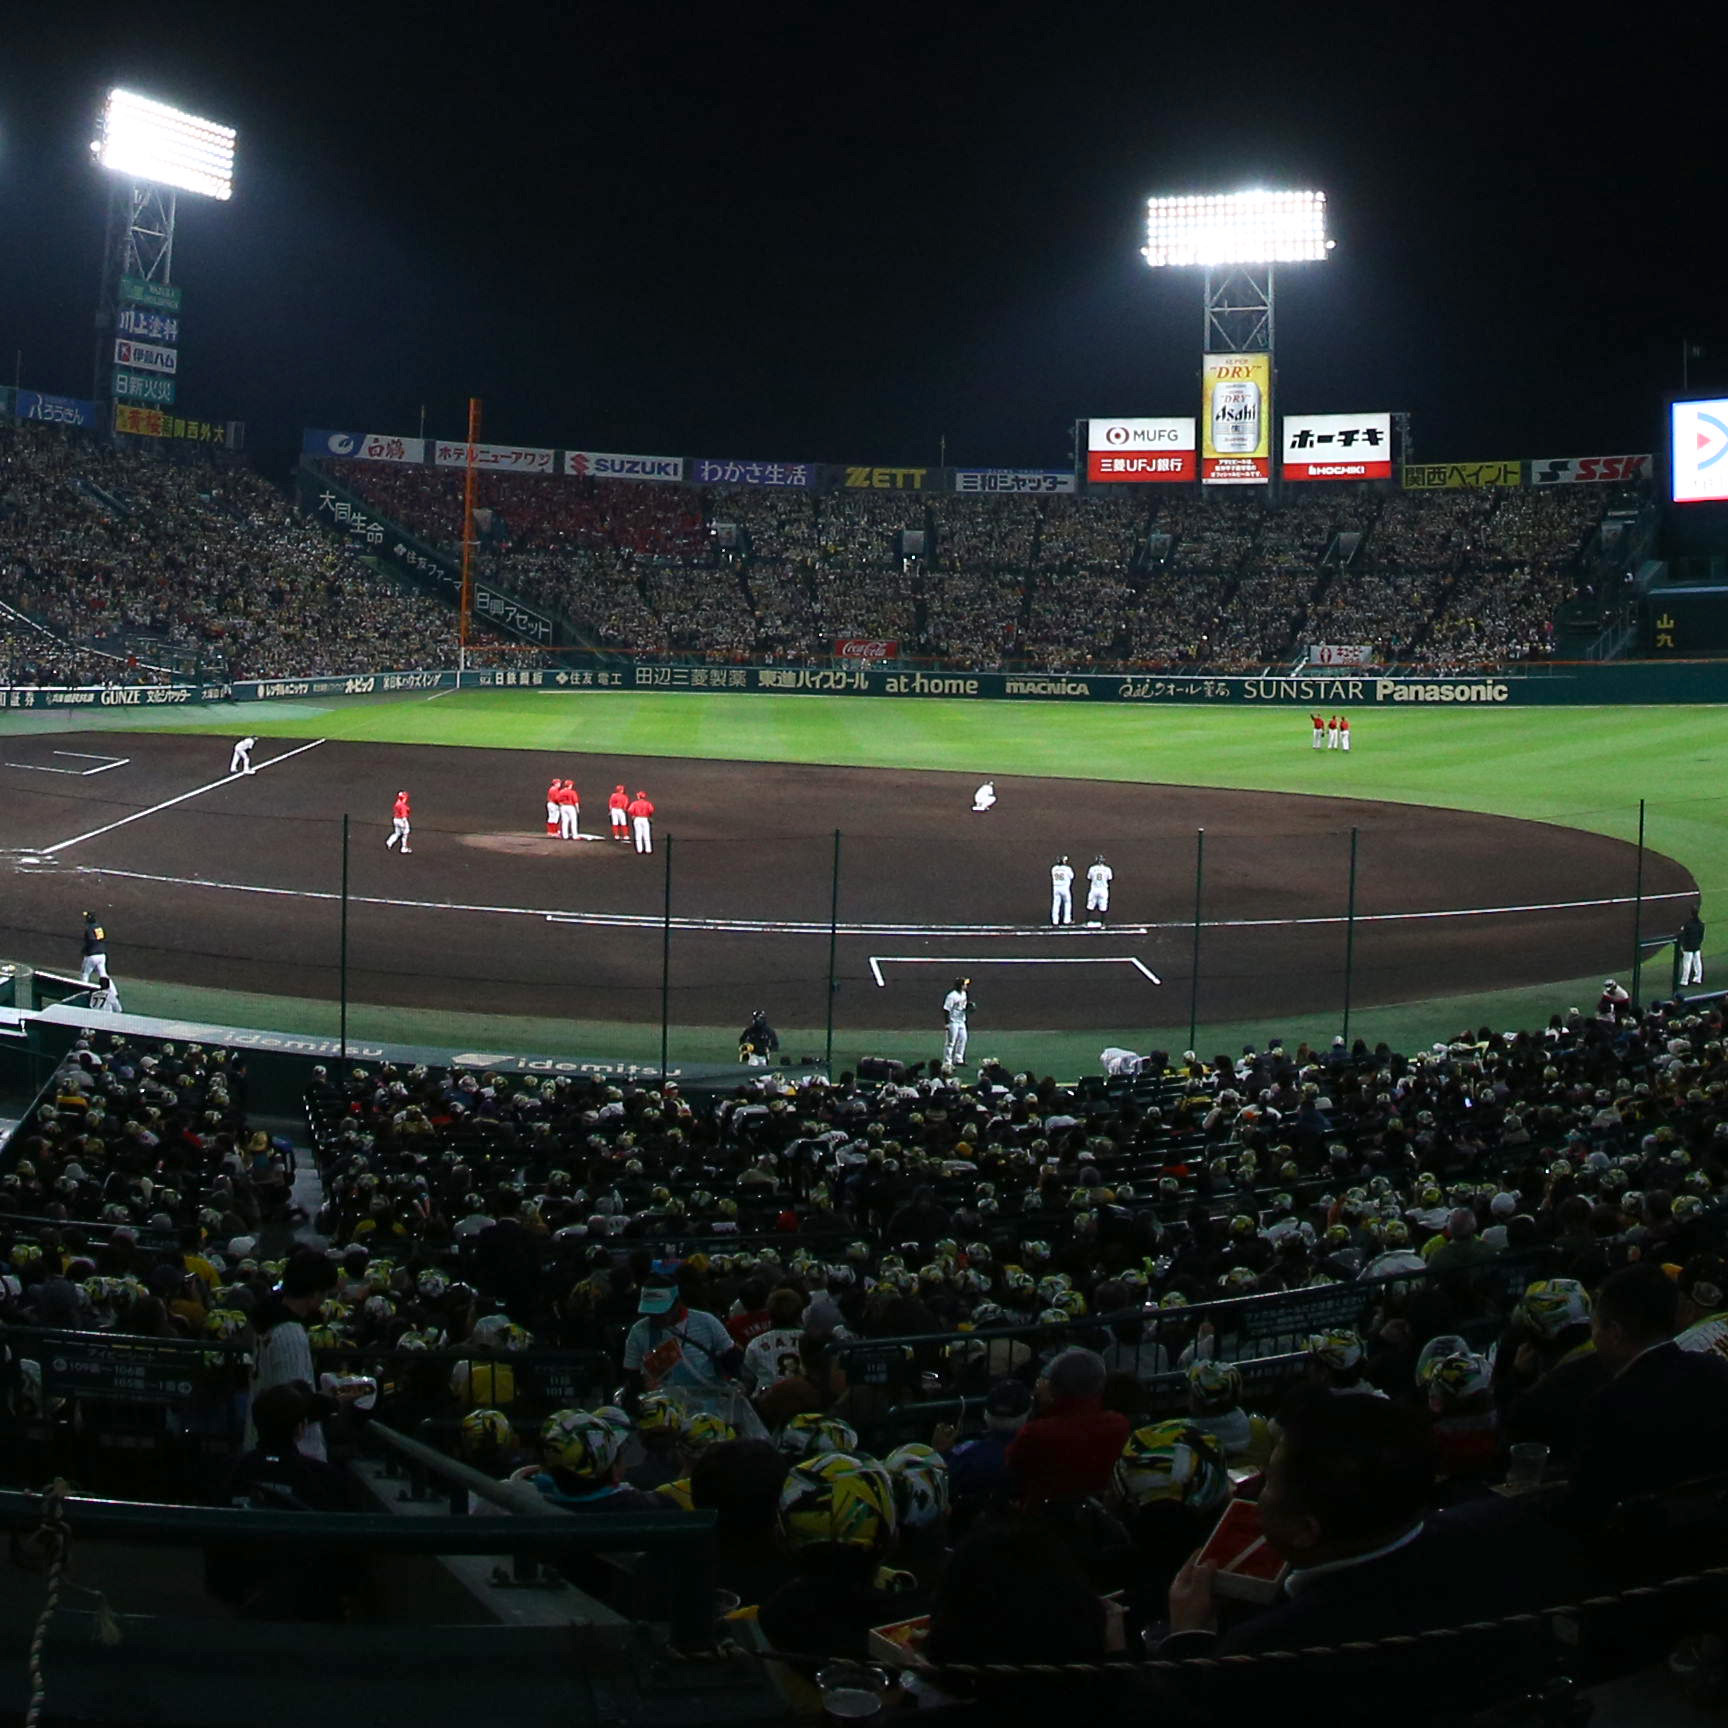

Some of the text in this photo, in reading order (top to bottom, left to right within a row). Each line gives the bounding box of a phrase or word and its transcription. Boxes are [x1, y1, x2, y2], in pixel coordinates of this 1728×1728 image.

[119, 309, 178, 342] 川上塗料
[115, 374, 171, 402] 日新火災
[1215, 403, 1257, 422] Asahi
[1133, 429, 1179, 442] MUFG
[1289, 428, 1385, 449] ホーチキ
[438, 445, 553, 467] ホテルニューアワジ
[593, 456, 680, 477] SUZUKI
[1100, 458, 1183, 473] 三菱UFJ銀行
[700, 459, 807, 487] わかさ生活
[843, 466, 927, 489] ZETT
[1404, 462, 1520, 488] 関西ペイント
[1574, 455, 1650, 482] SSK
[318, 489, 385, 545] 大同生命
[477, 591, 550, 641] 日興アセット
[1655, 613, 1675, 649] 山九
[635, 667, 748, 688] 田辺三菱製薬
[757, 670, 870, 690] 東進ハイスクール
[100, 690, 141, 705] GUNZE
[1243, 680, 1365, 699] SUNSTAR
[1375, 679, 1509, 701] Panasonic
